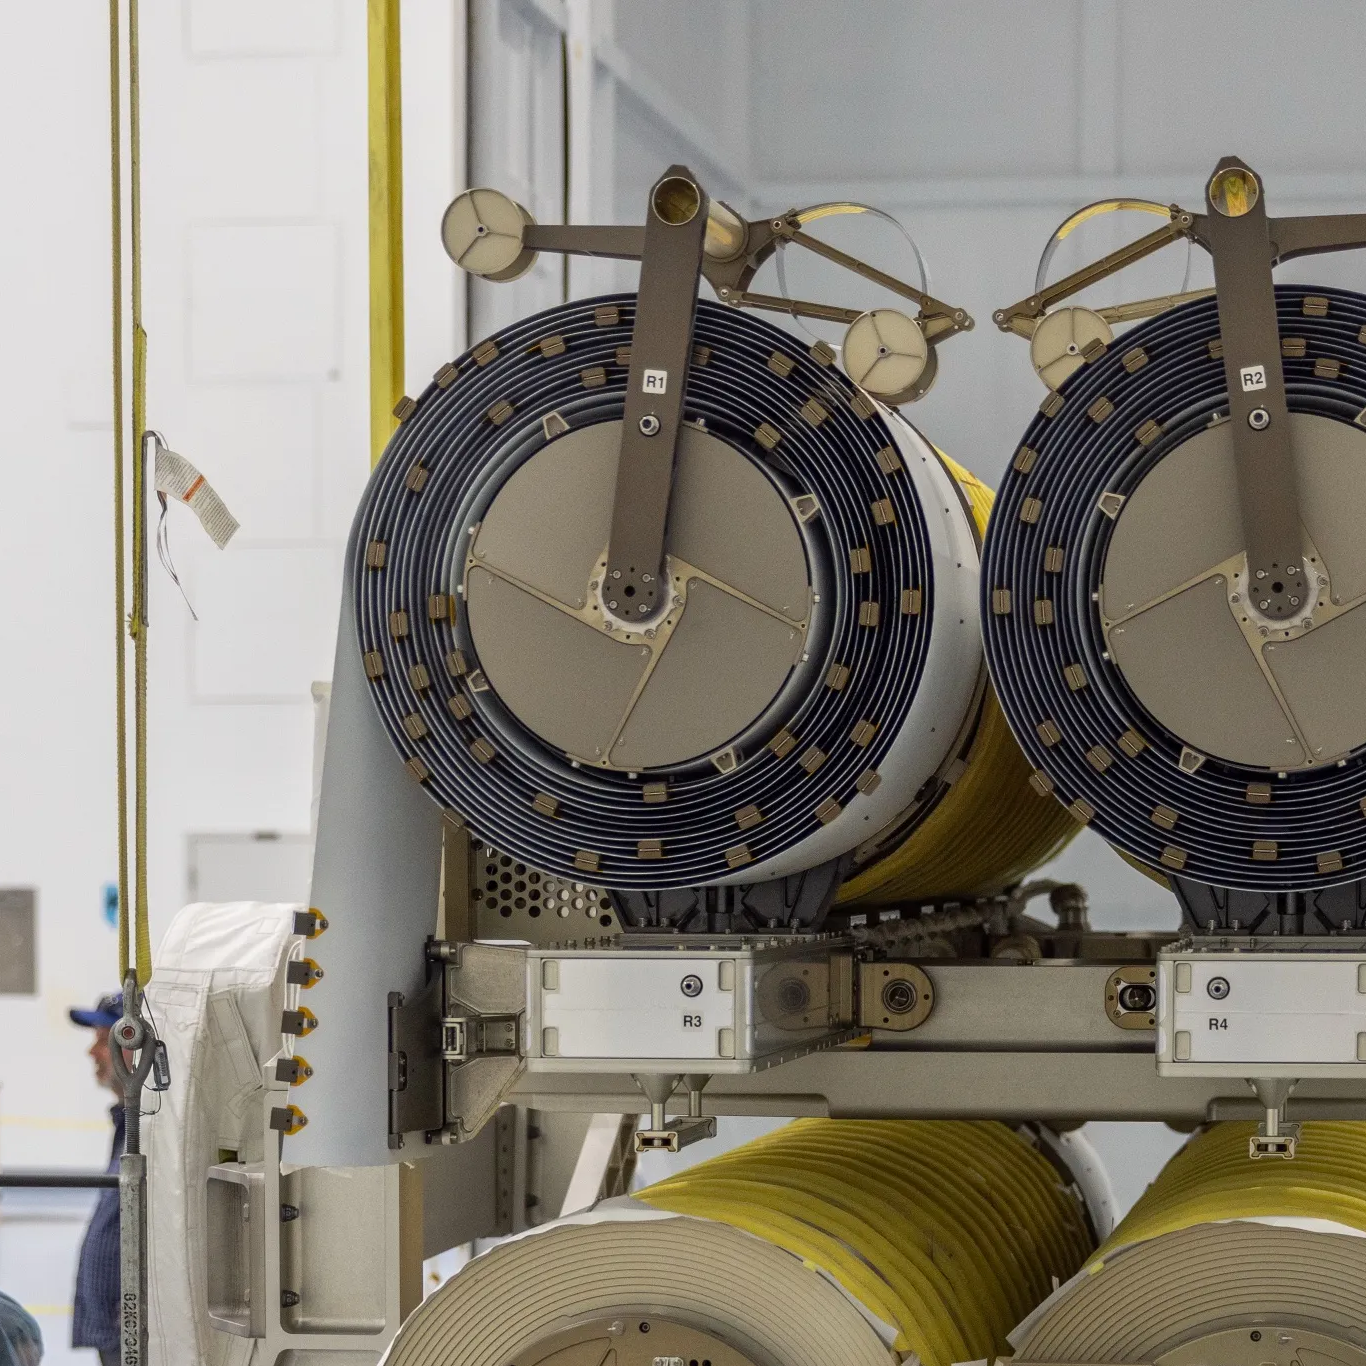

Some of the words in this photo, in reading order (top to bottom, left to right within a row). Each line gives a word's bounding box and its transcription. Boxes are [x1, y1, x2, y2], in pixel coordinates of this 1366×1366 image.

[646, 375, 666, 390] R1
[1244, 371, 1264, 387] R2
[683, 1015, 702, 1028] R3
[1208, 1018, 1229, 1031] R4
